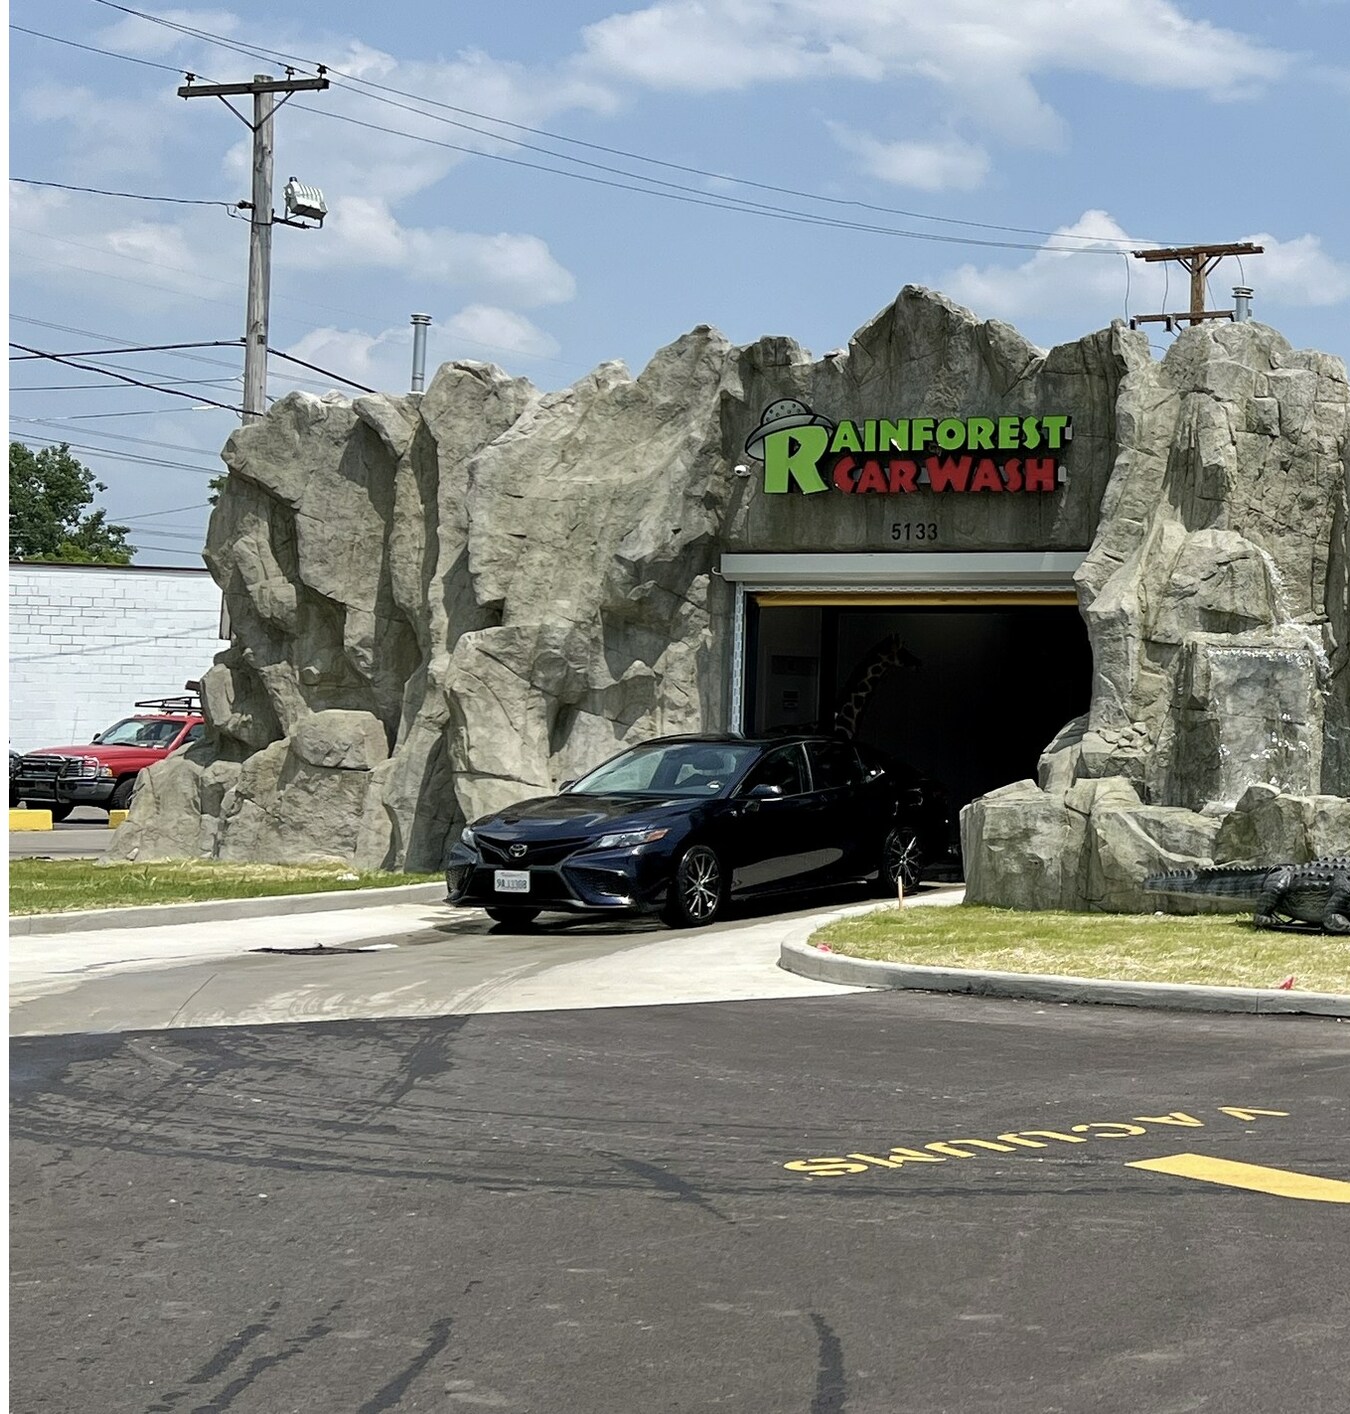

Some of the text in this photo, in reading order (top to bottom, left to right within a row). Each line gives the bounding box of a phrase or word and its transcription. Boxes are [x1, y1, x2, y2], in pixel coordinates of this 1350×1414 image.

[764, 416, 1067, 494] RAINFOREST
[833, 455, 1055, 493] CAR WASH
[891, 523, 938, 540] 5133
[783, 1106, 1290, 1178] VACUUMS
